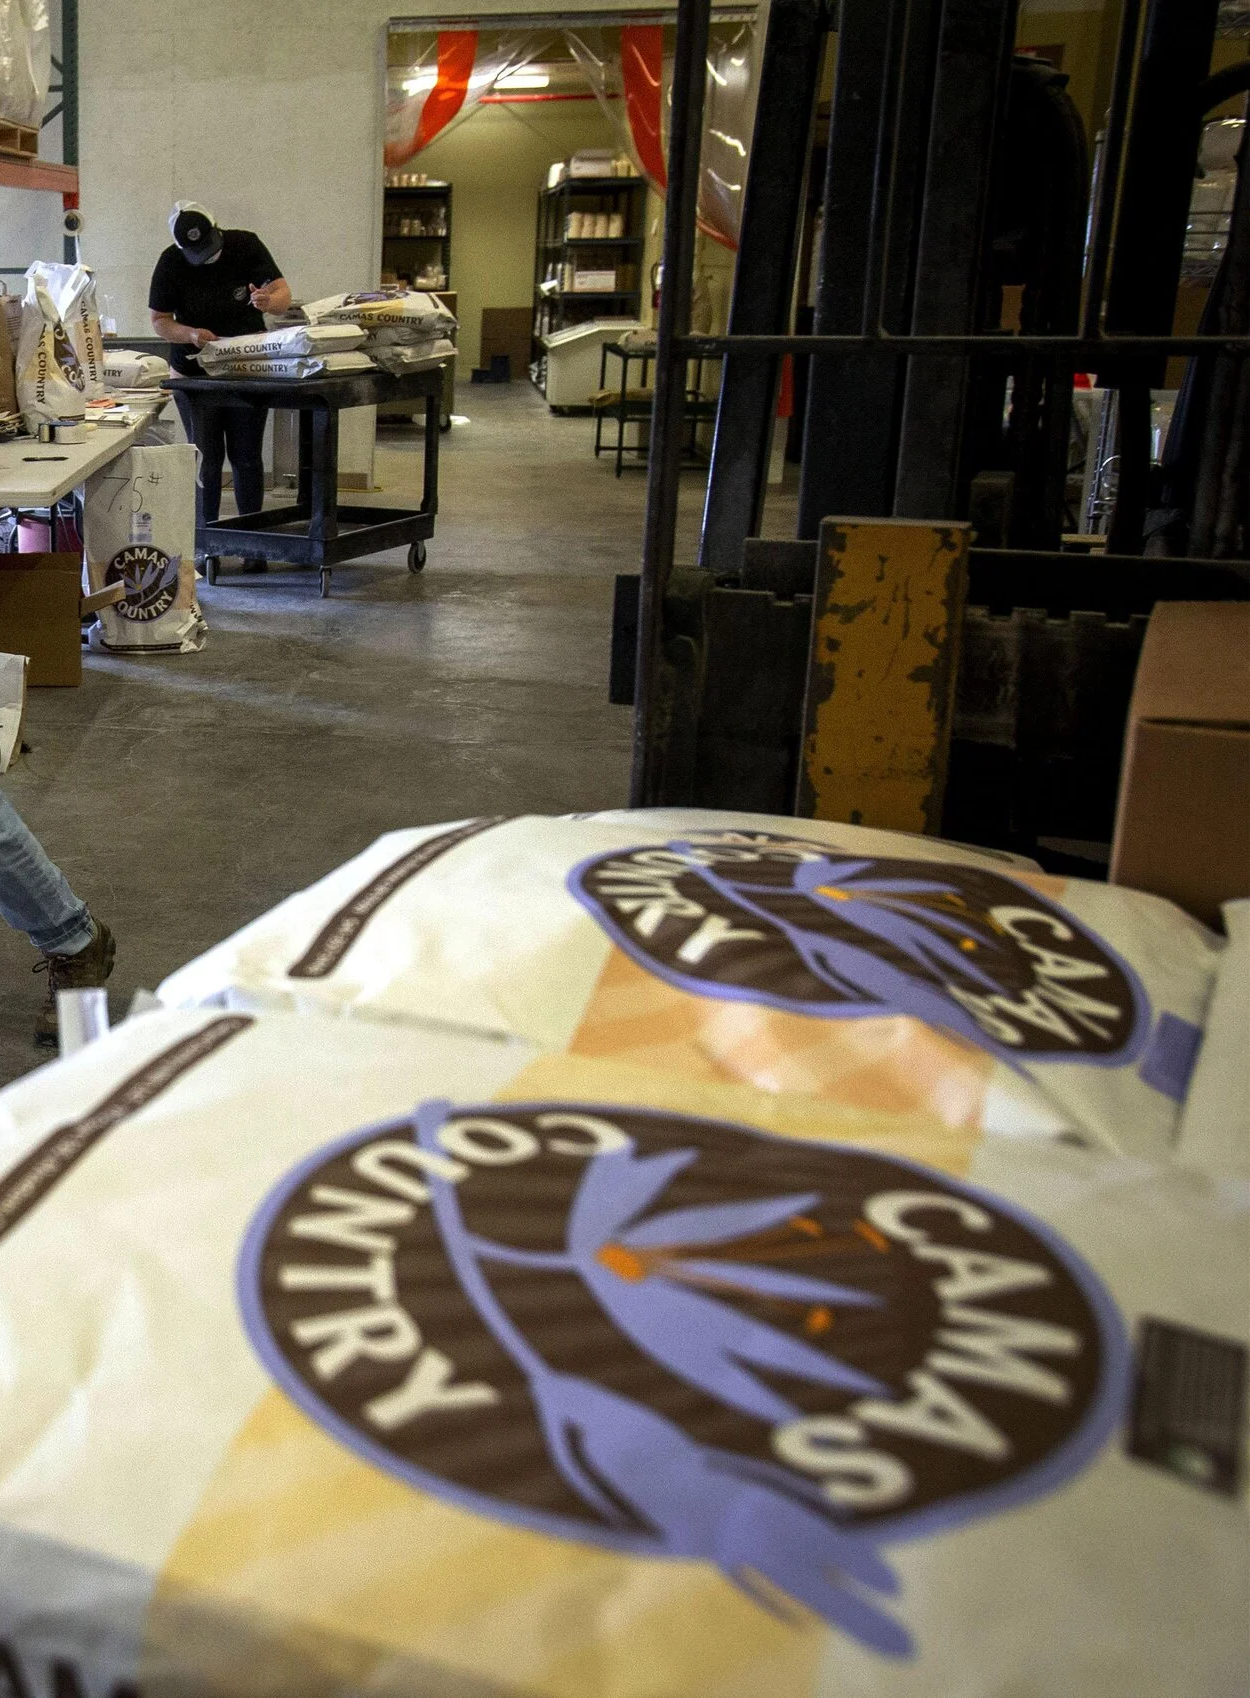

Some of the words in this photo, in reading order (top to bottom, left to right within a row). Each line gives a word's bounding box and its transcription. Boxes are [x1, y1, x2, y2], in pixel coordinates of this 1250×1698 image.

[340, 313, 374, 321] CAMAS
[377, 314, 424, 325] COUNTRY
[85, 337, 97, 382] COUNTRY
[244, 342, 282, 354] COUNTRY
[37, 352, 46, 404] COUNTRY
[250, 363, 288, 372] COUNTRY
[114, 547, 170, 570] CAMAS
[117, 590, 173, 620] OUNTRY
[279, 1113, 631, 1429] COUNTRY
[771, 1191, 1081, 1506] CAMAS
